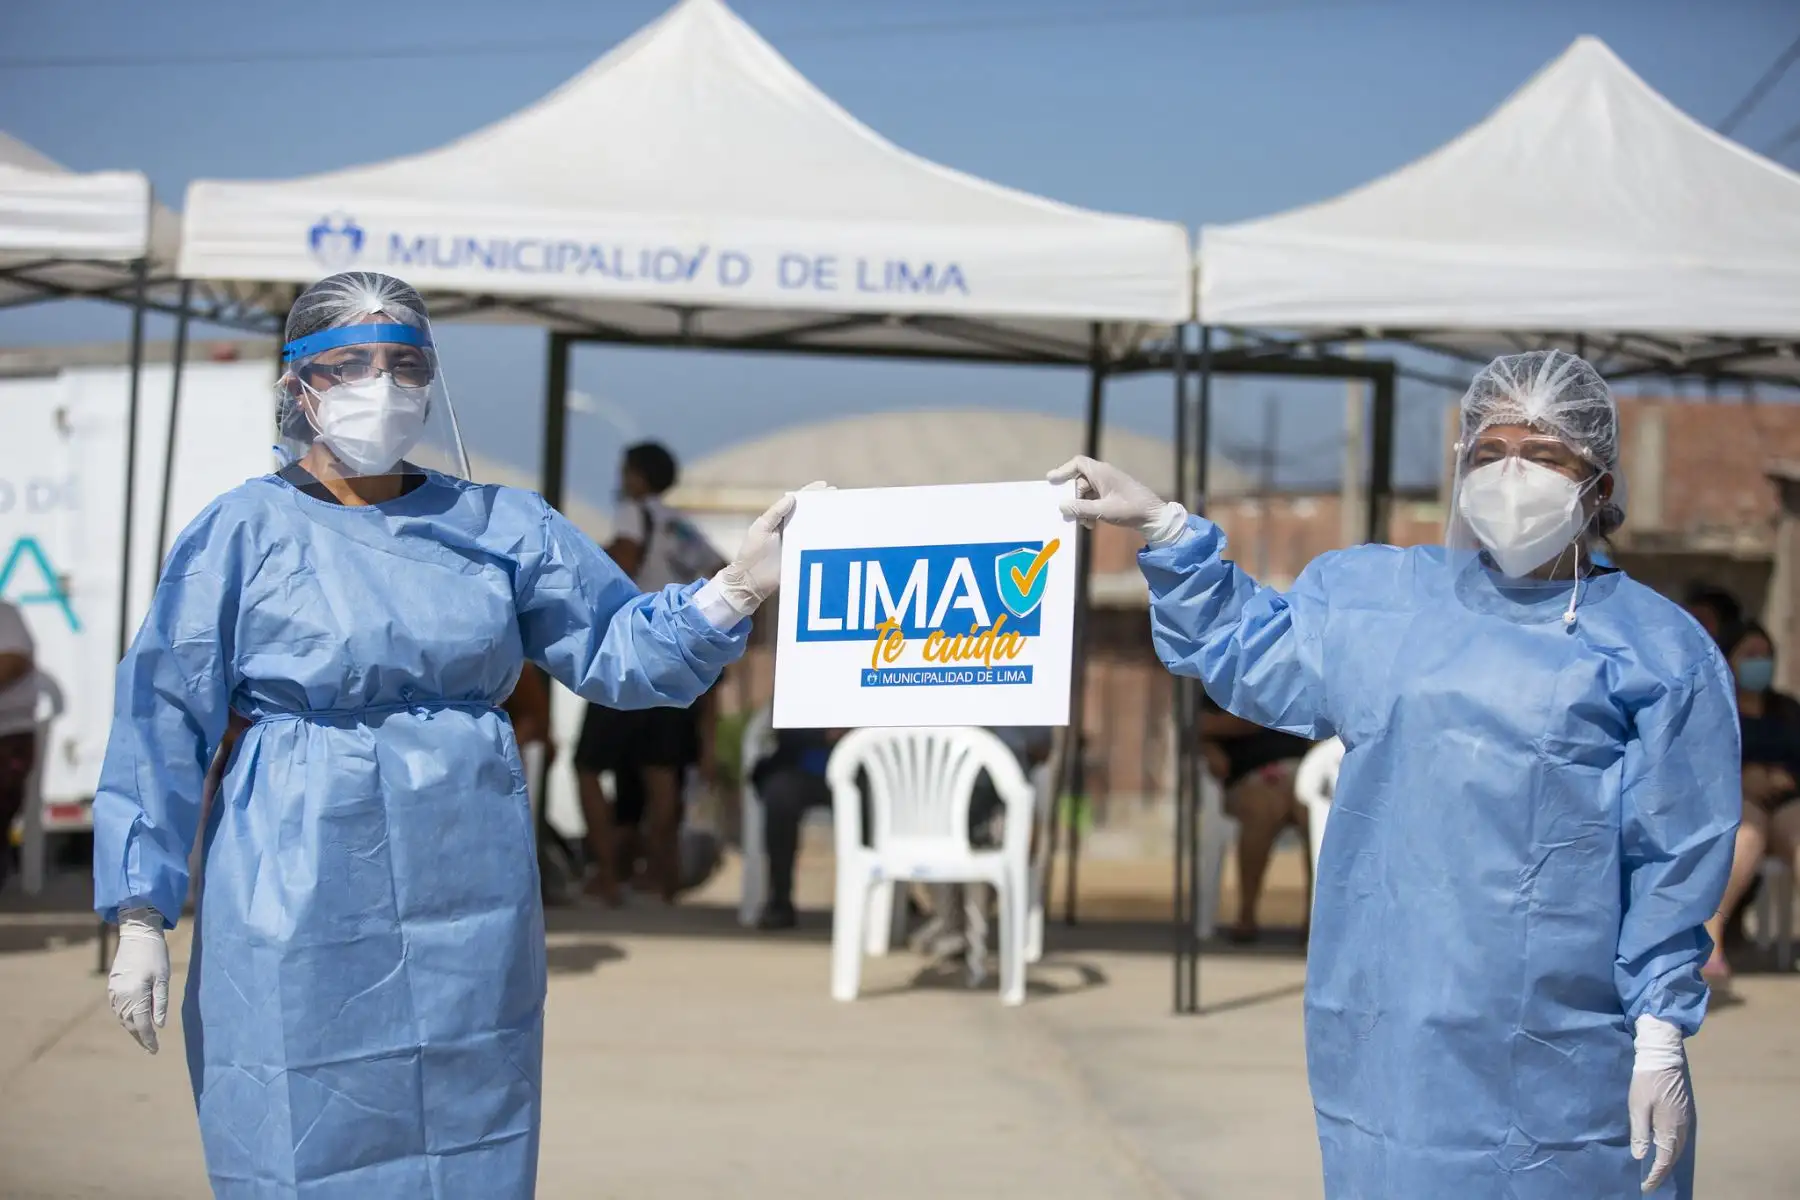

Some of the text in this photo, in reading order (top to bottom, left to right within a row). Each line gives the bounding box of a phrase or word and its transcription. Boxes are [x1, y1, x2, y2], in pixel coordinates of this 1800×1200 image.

[777, 250, 838, 291] DE
[857, 256, 970, 296] LIMA
[807, 557, 992, 631] LIMA
[871, 613, 1027, 672] te cuida
[882, 670, 1026, 684] MUNICIPALIDAD DE LIMA
